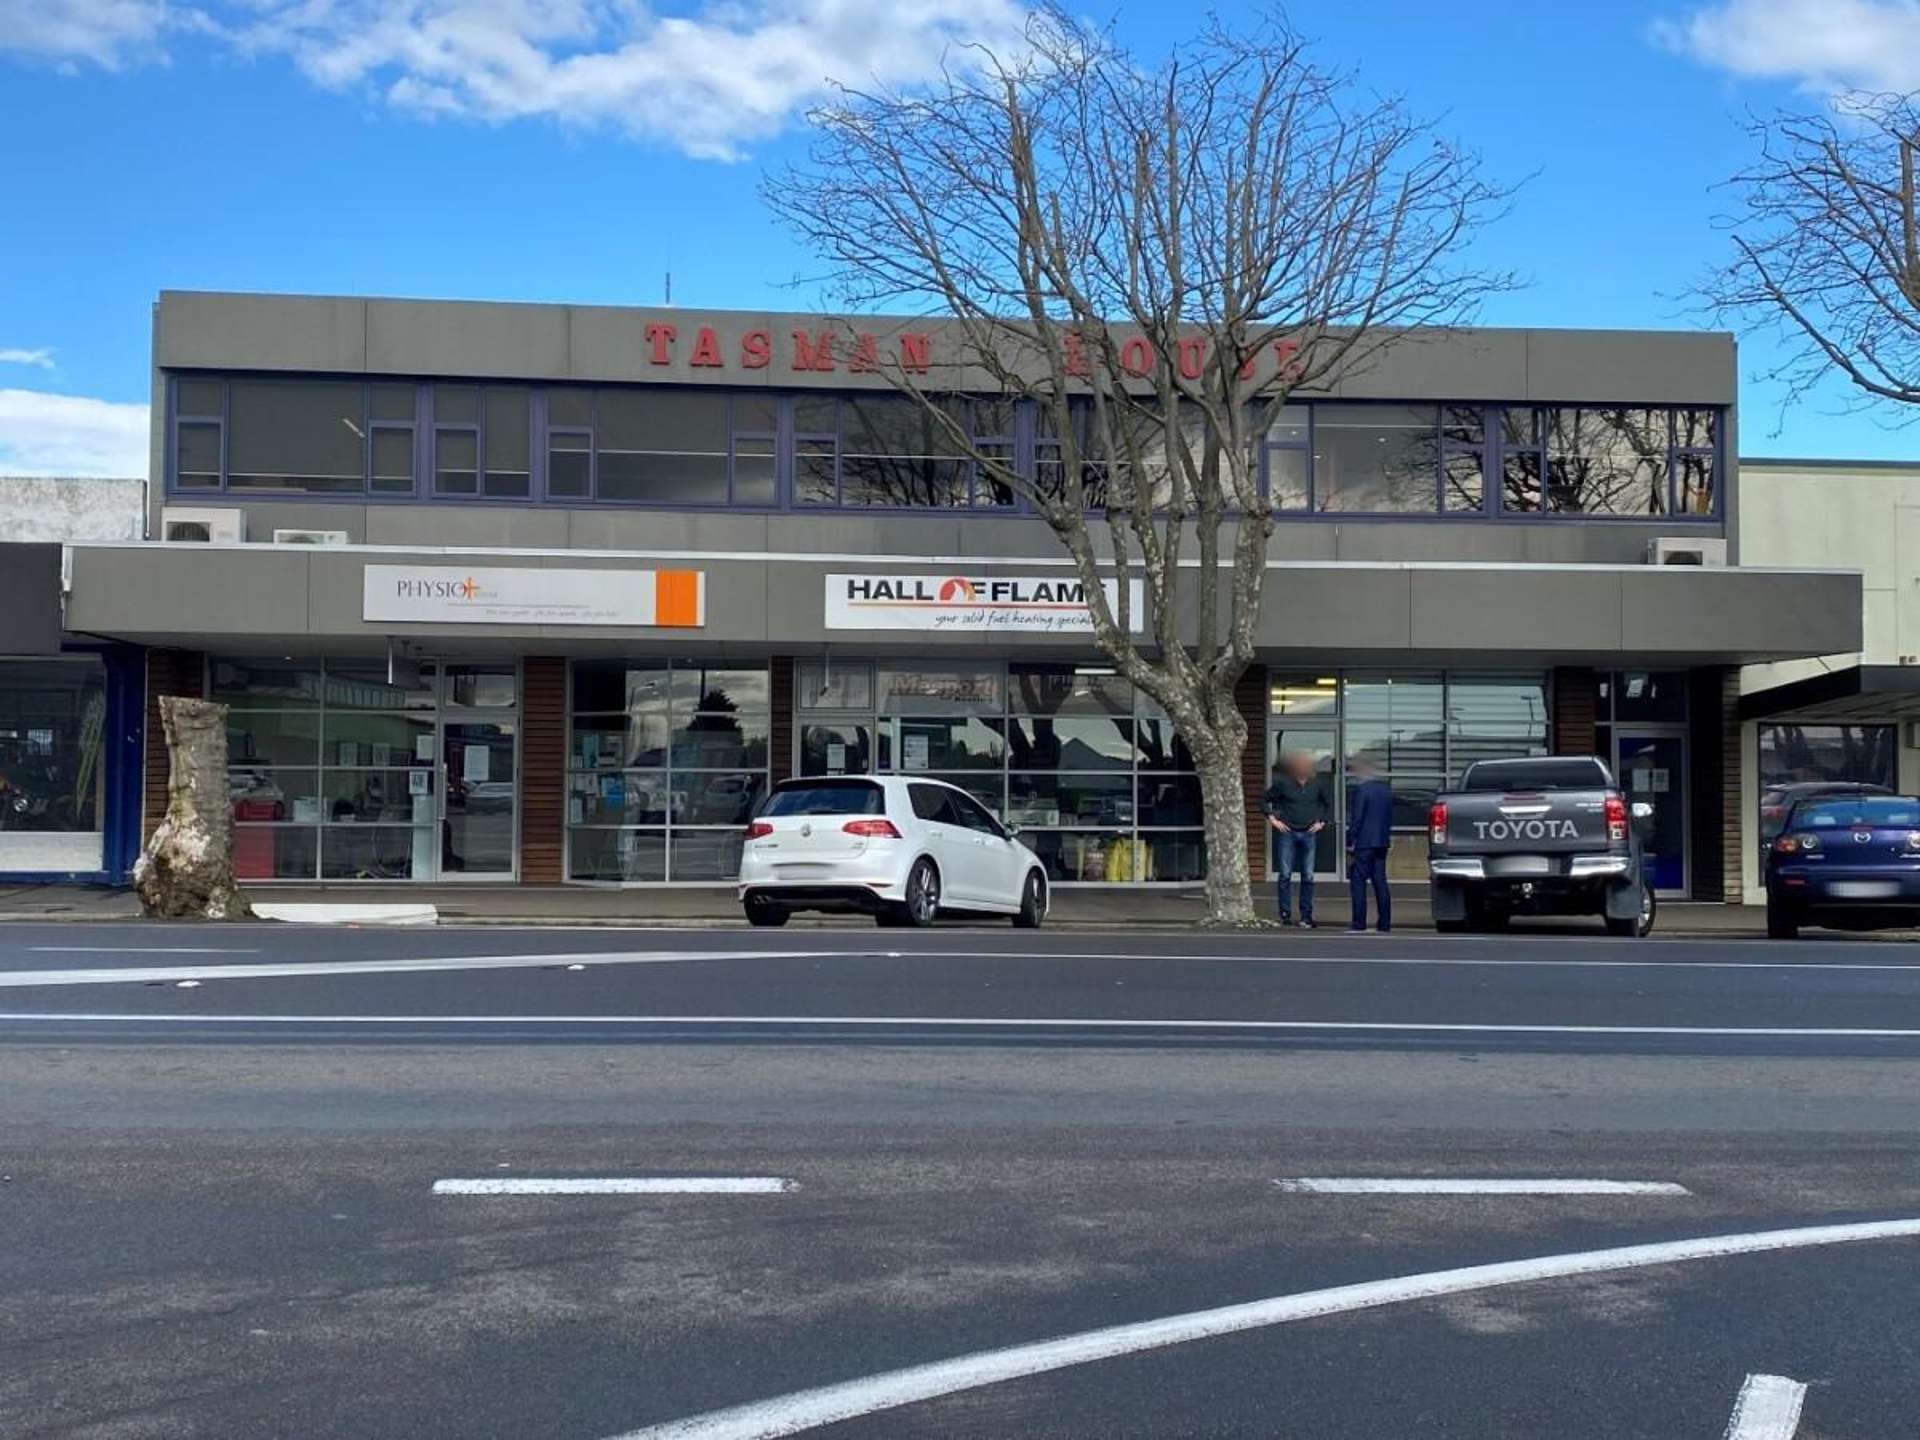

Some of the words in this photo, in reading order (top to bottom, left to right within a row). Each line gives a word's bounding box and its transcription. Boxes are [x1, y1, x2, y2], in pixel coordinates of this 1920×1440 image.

[644, 324, 930, 374] TASMAN
[847, 579, 934, 601] HALL
[992, 581, 1106, 603] FLAM
[1472, 819, 1580, 840] TOYOTA
